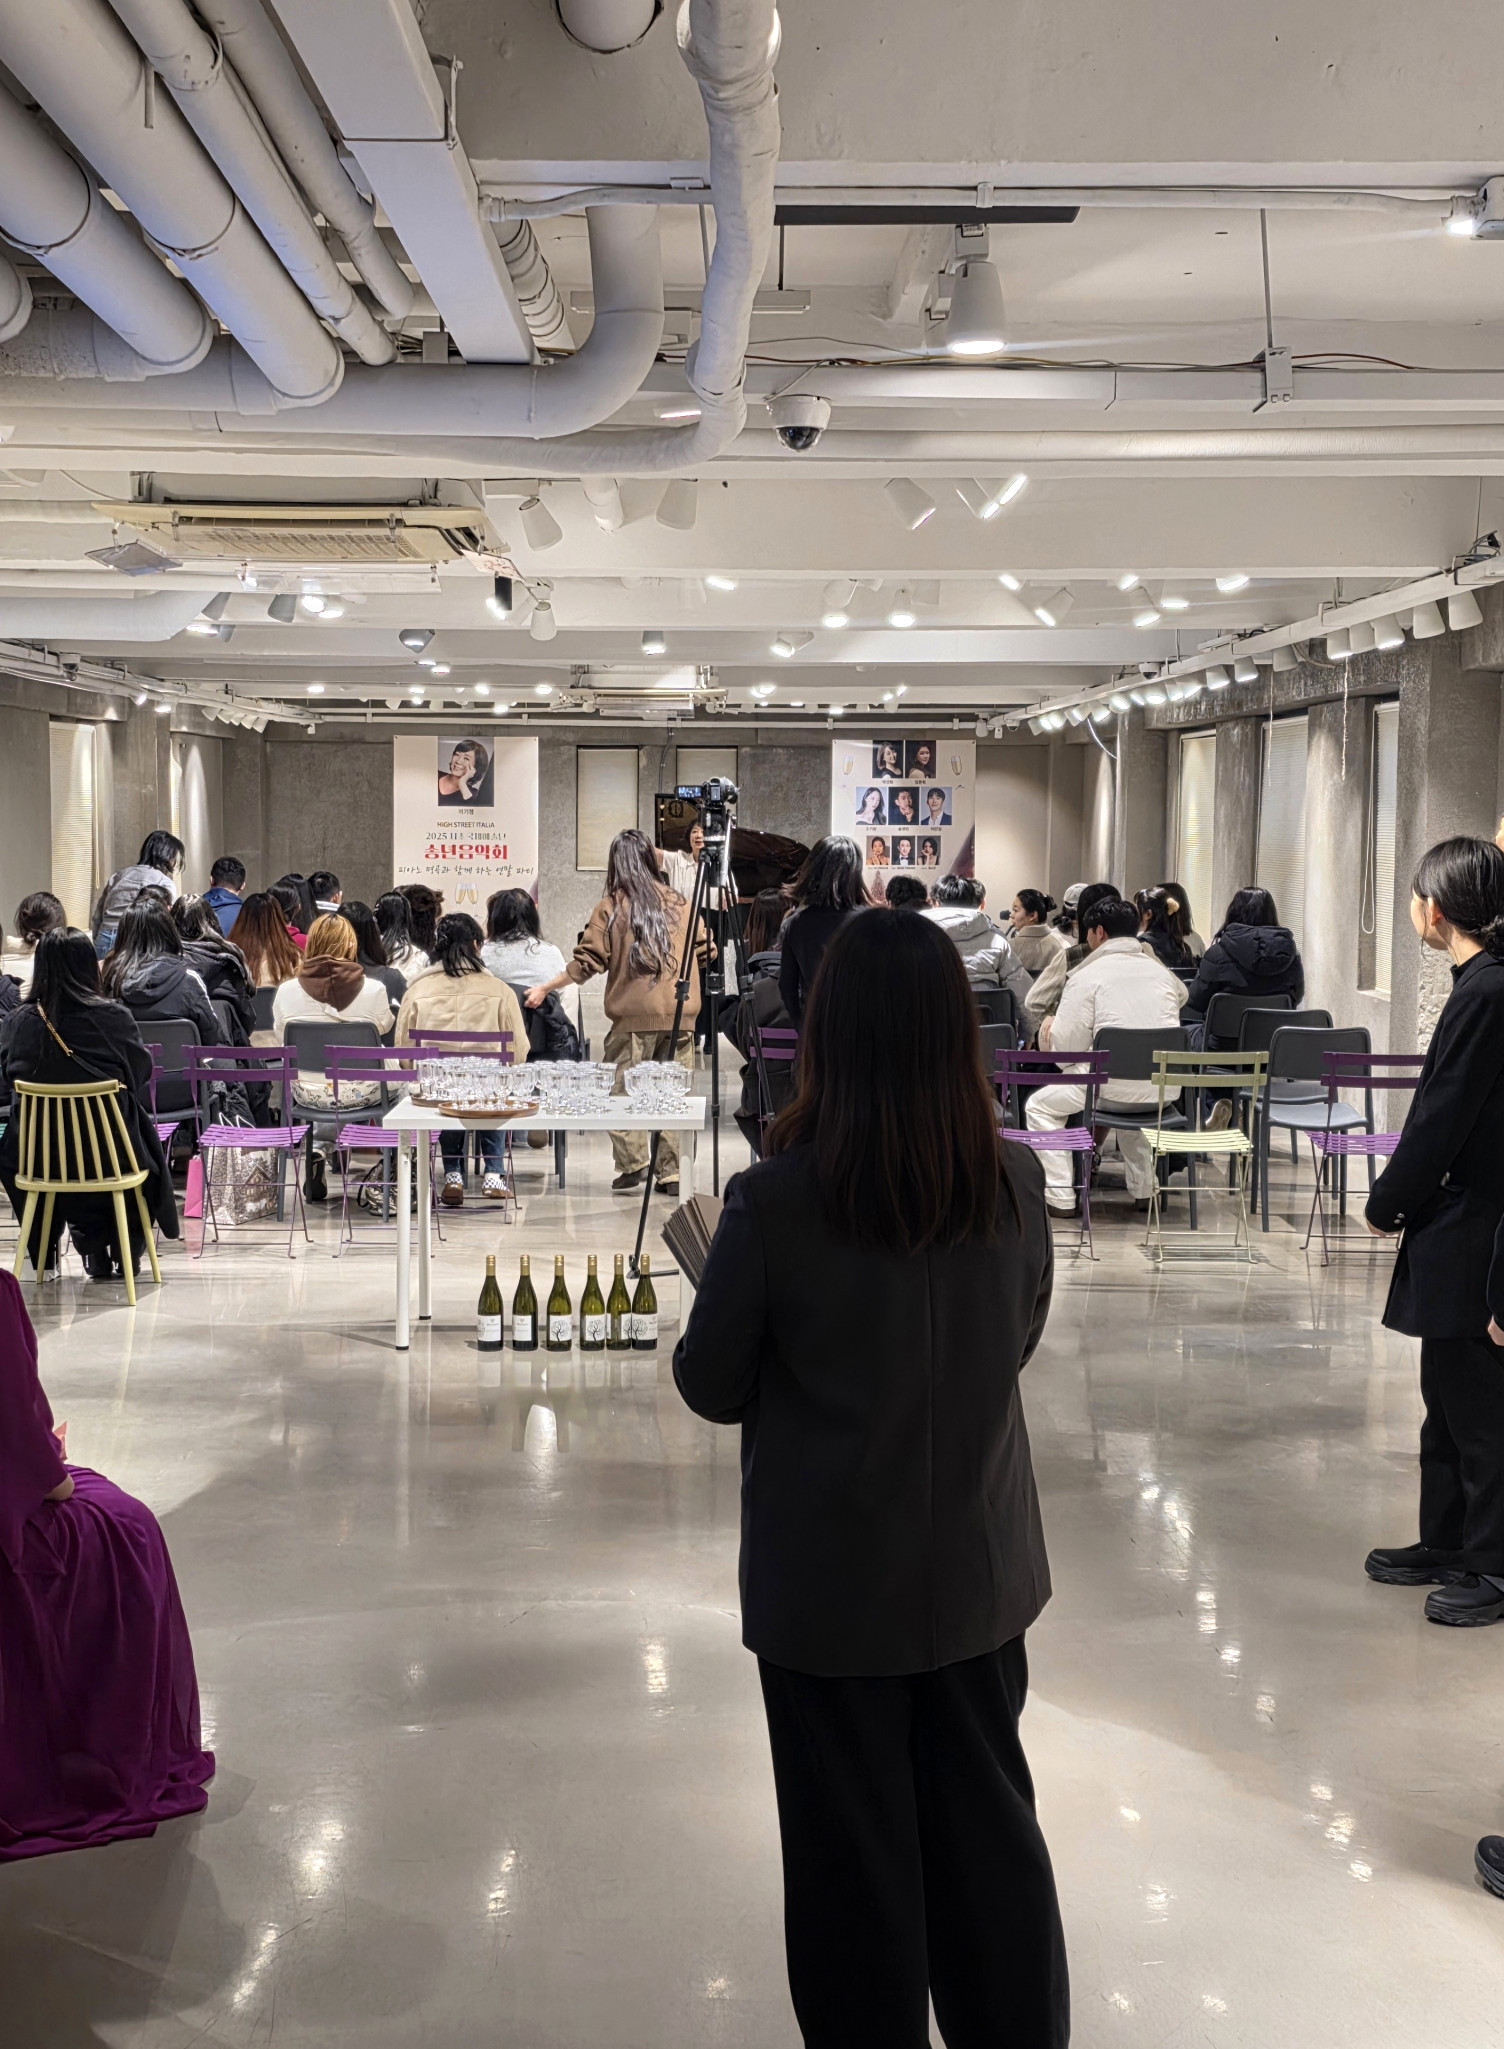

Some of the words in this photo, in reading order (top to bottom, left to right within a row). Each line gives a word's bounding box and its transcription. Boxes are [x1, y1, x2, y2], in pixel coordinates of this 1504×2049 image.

[425, 832, 447, 840] 2025
[424, 844, 508, 860] 송년음악회
[398, 866, 422, 875] 피아노
[426, 866, 450, 876] 명곡과
[496, 864, 513, 877] 연말
